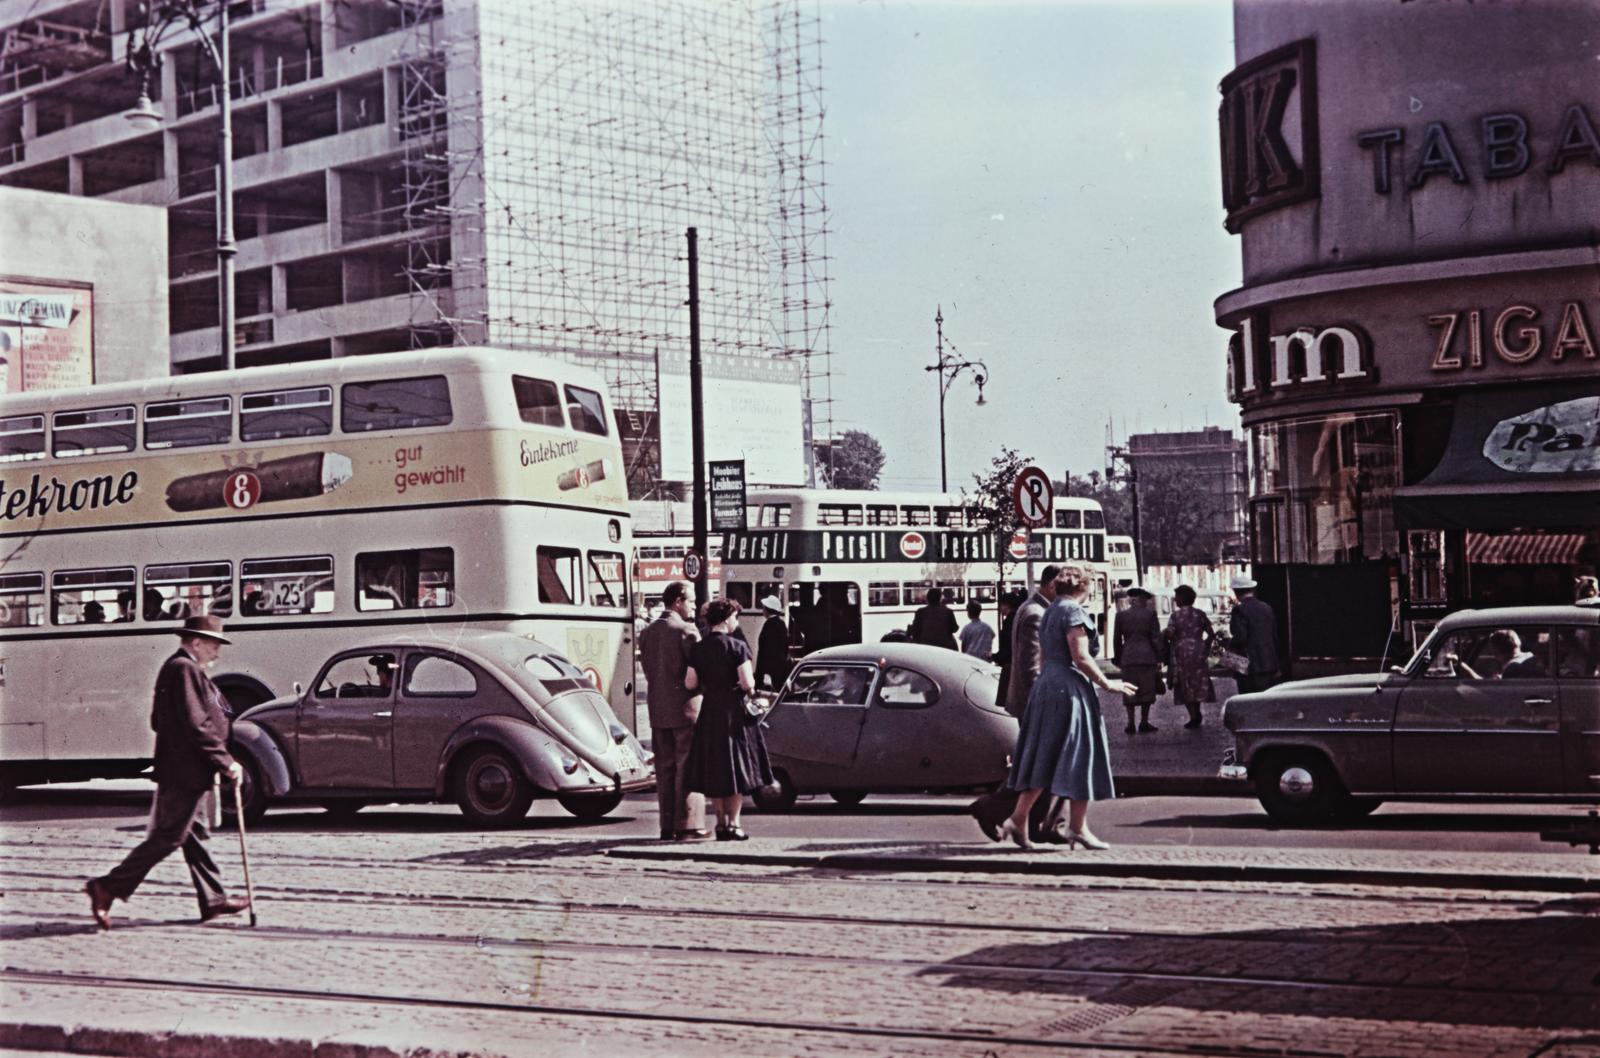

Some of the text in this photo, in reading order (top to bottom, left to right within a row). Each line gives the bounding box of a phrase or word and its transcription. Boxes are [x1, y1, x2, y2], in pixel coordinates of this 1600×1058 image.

[1428, 301, 1598, 371] ZIGA
[1501, 422, 1600, 454] Pa
[394, 464, 465, 494] gewählt
[1030, 479, 1042, 516] P
[728, 533, 788, 560] Persil
[822, 532, 886, 559] Persil
[941, 533, 995, 559] Persil
[1045, 534, 1094, 559] Persil
[644, 566, 666, 578] gute
[686, 557, 697, 575] 60
